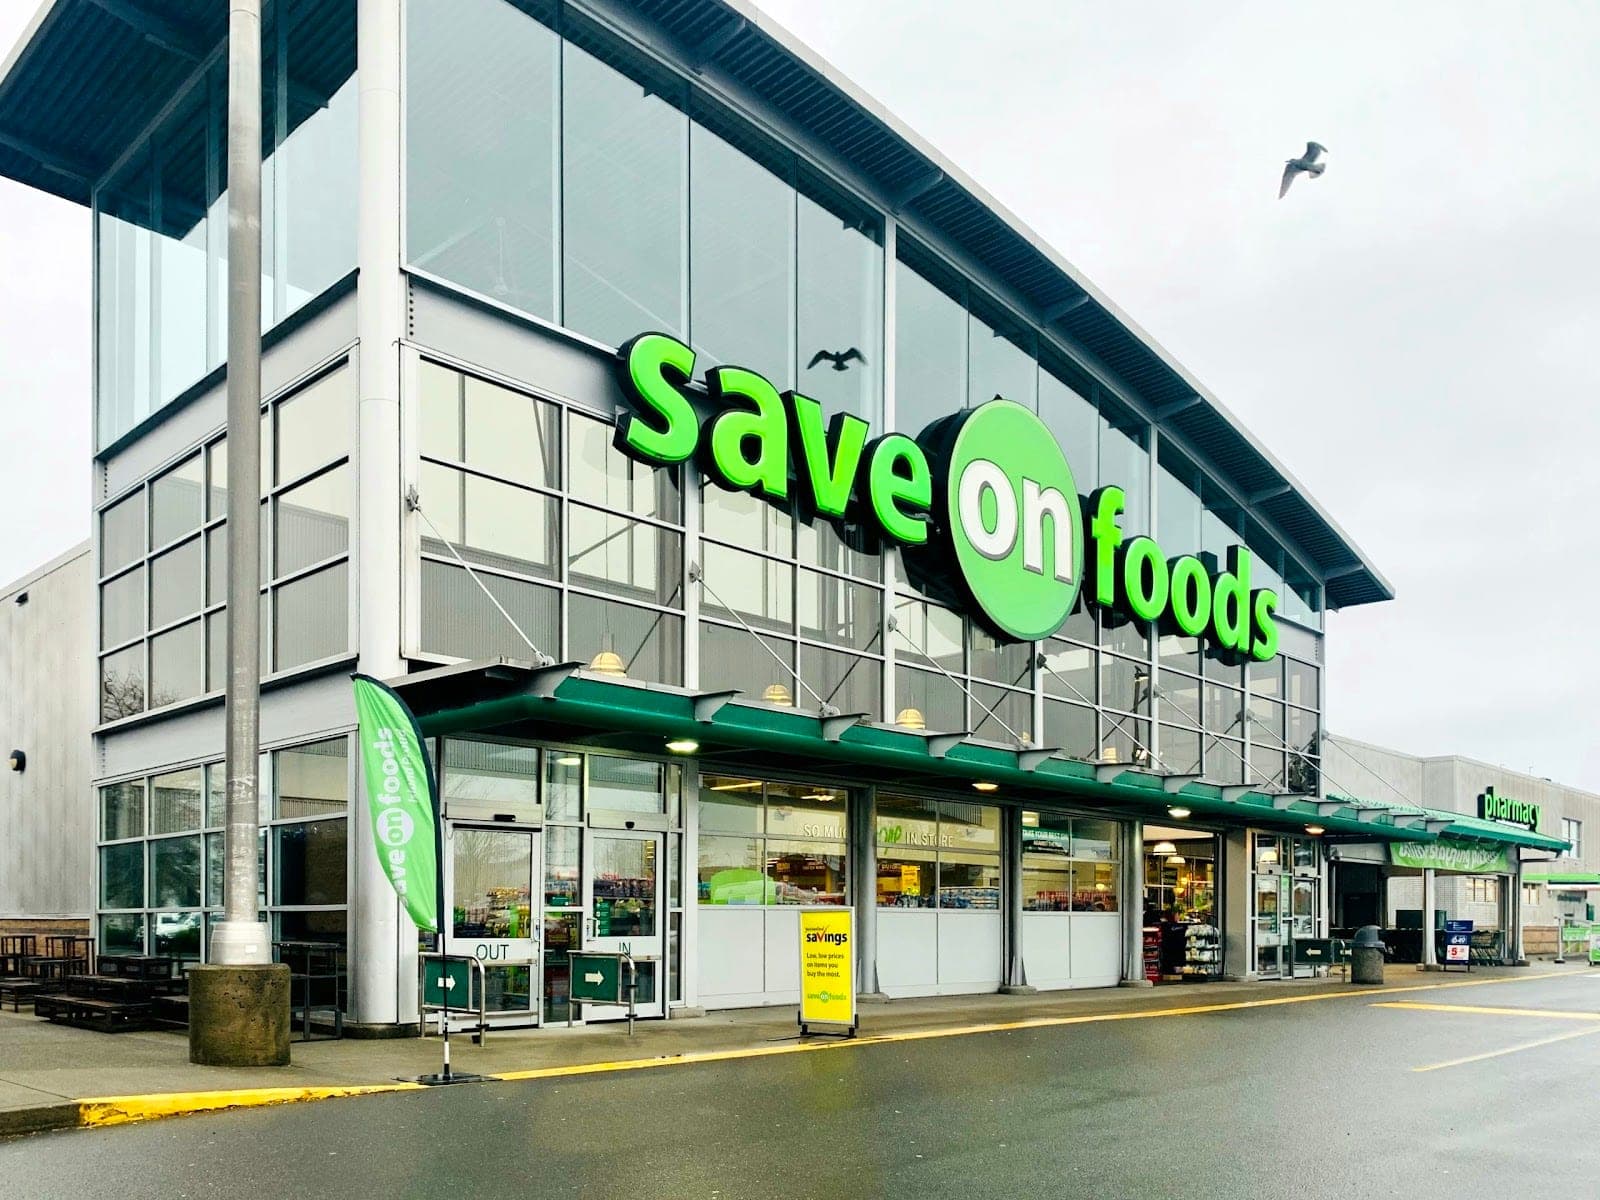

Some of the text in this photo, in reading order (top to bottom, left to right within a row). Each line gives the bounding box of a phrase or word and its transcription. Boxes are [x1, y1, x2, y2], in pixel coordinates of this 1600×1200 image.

[616, 332, 1279, 661] save on foods
[373, 727, 402, 805] foods
[1482, 786, 1542, 832] pharmacy
[804, 824, 819, 837] SO
[922, 832, 953, 847] STORE
[618, 941, 631, 958] IN
[806, 931, 848, 946] savings
[475, 943, 510, 961] OUT
